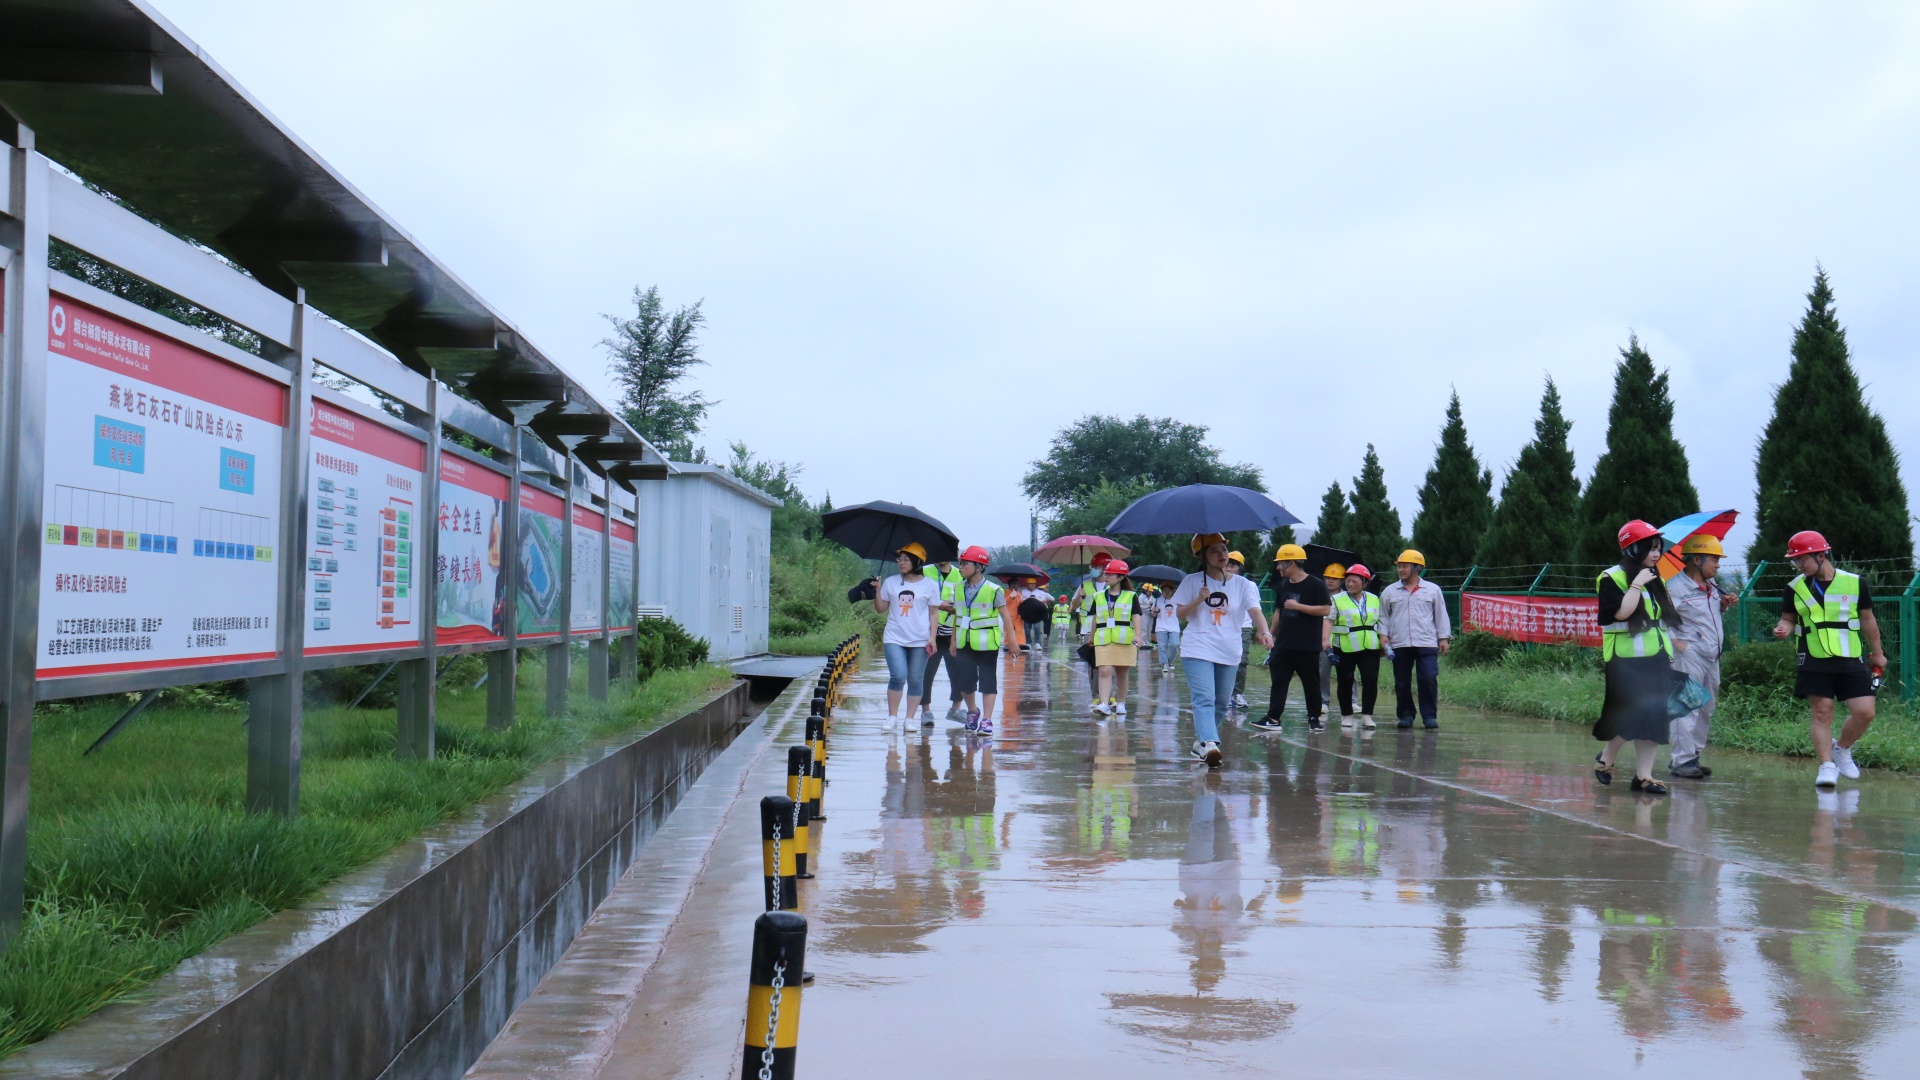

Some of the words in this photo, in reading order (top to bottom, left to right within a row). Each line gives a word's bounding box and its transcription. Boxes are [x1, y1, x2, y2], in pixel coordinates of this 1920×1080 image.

[73, 317, 151, 360] 烟台栖霞中联水泥有限公司
[109, 384, 244, 442] 燕地石灰石矿山风险点公示
[100, 424, 143, 447] 操作及作业活动类
[110, 447, 132, 466] 风险点
[55, 573, 127, 593] 操作及作业活动风险点
